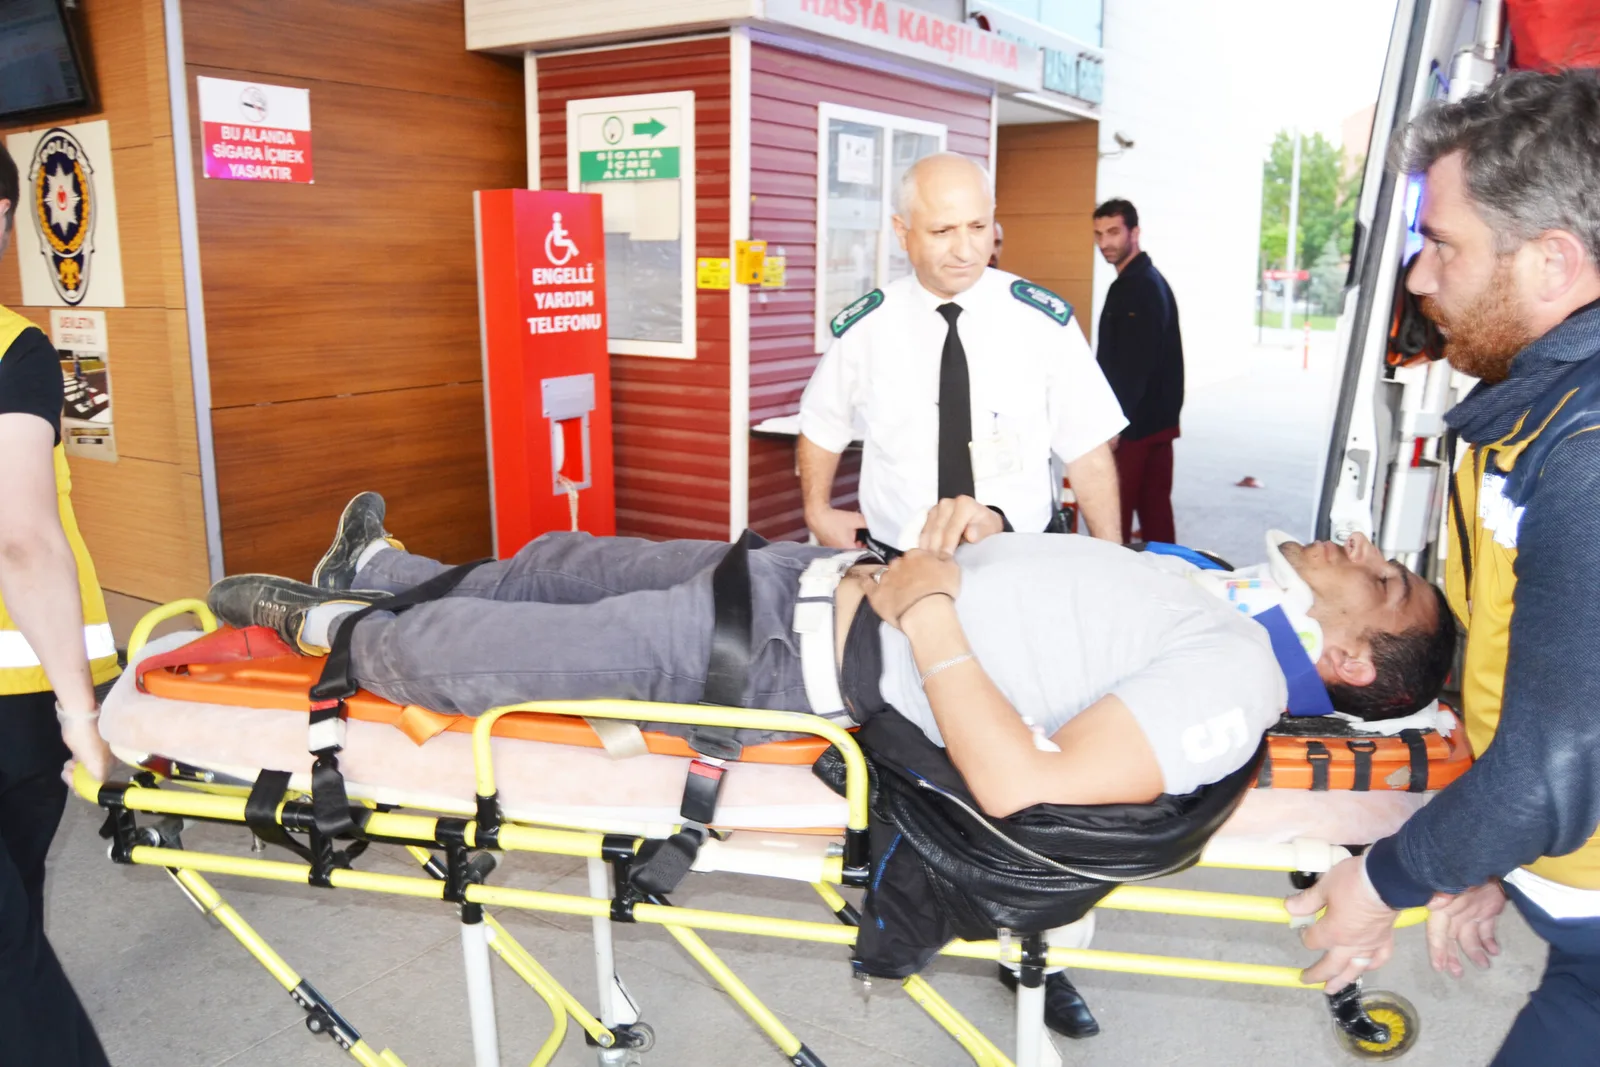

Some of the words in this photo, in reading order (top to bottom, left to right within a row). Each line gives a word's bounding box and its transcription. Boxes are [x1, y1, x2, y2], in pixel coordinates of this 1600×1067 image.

[898, 8, 1019, 71] KARŞILAMA
[221, 126, 241, 141] BU
[242, 127, 296, 145] ALANDA
[212, 141, 264, 161] SİGARA
[264, 145, 305, 165] İÇMEK
[228, 162, 292, 180] YASAKTIR
[532, 262, 595, 286] ENGELLİ
[533, 290, 594, 310] YARDIM
[527, 313, 602, 335] TELEFONU
